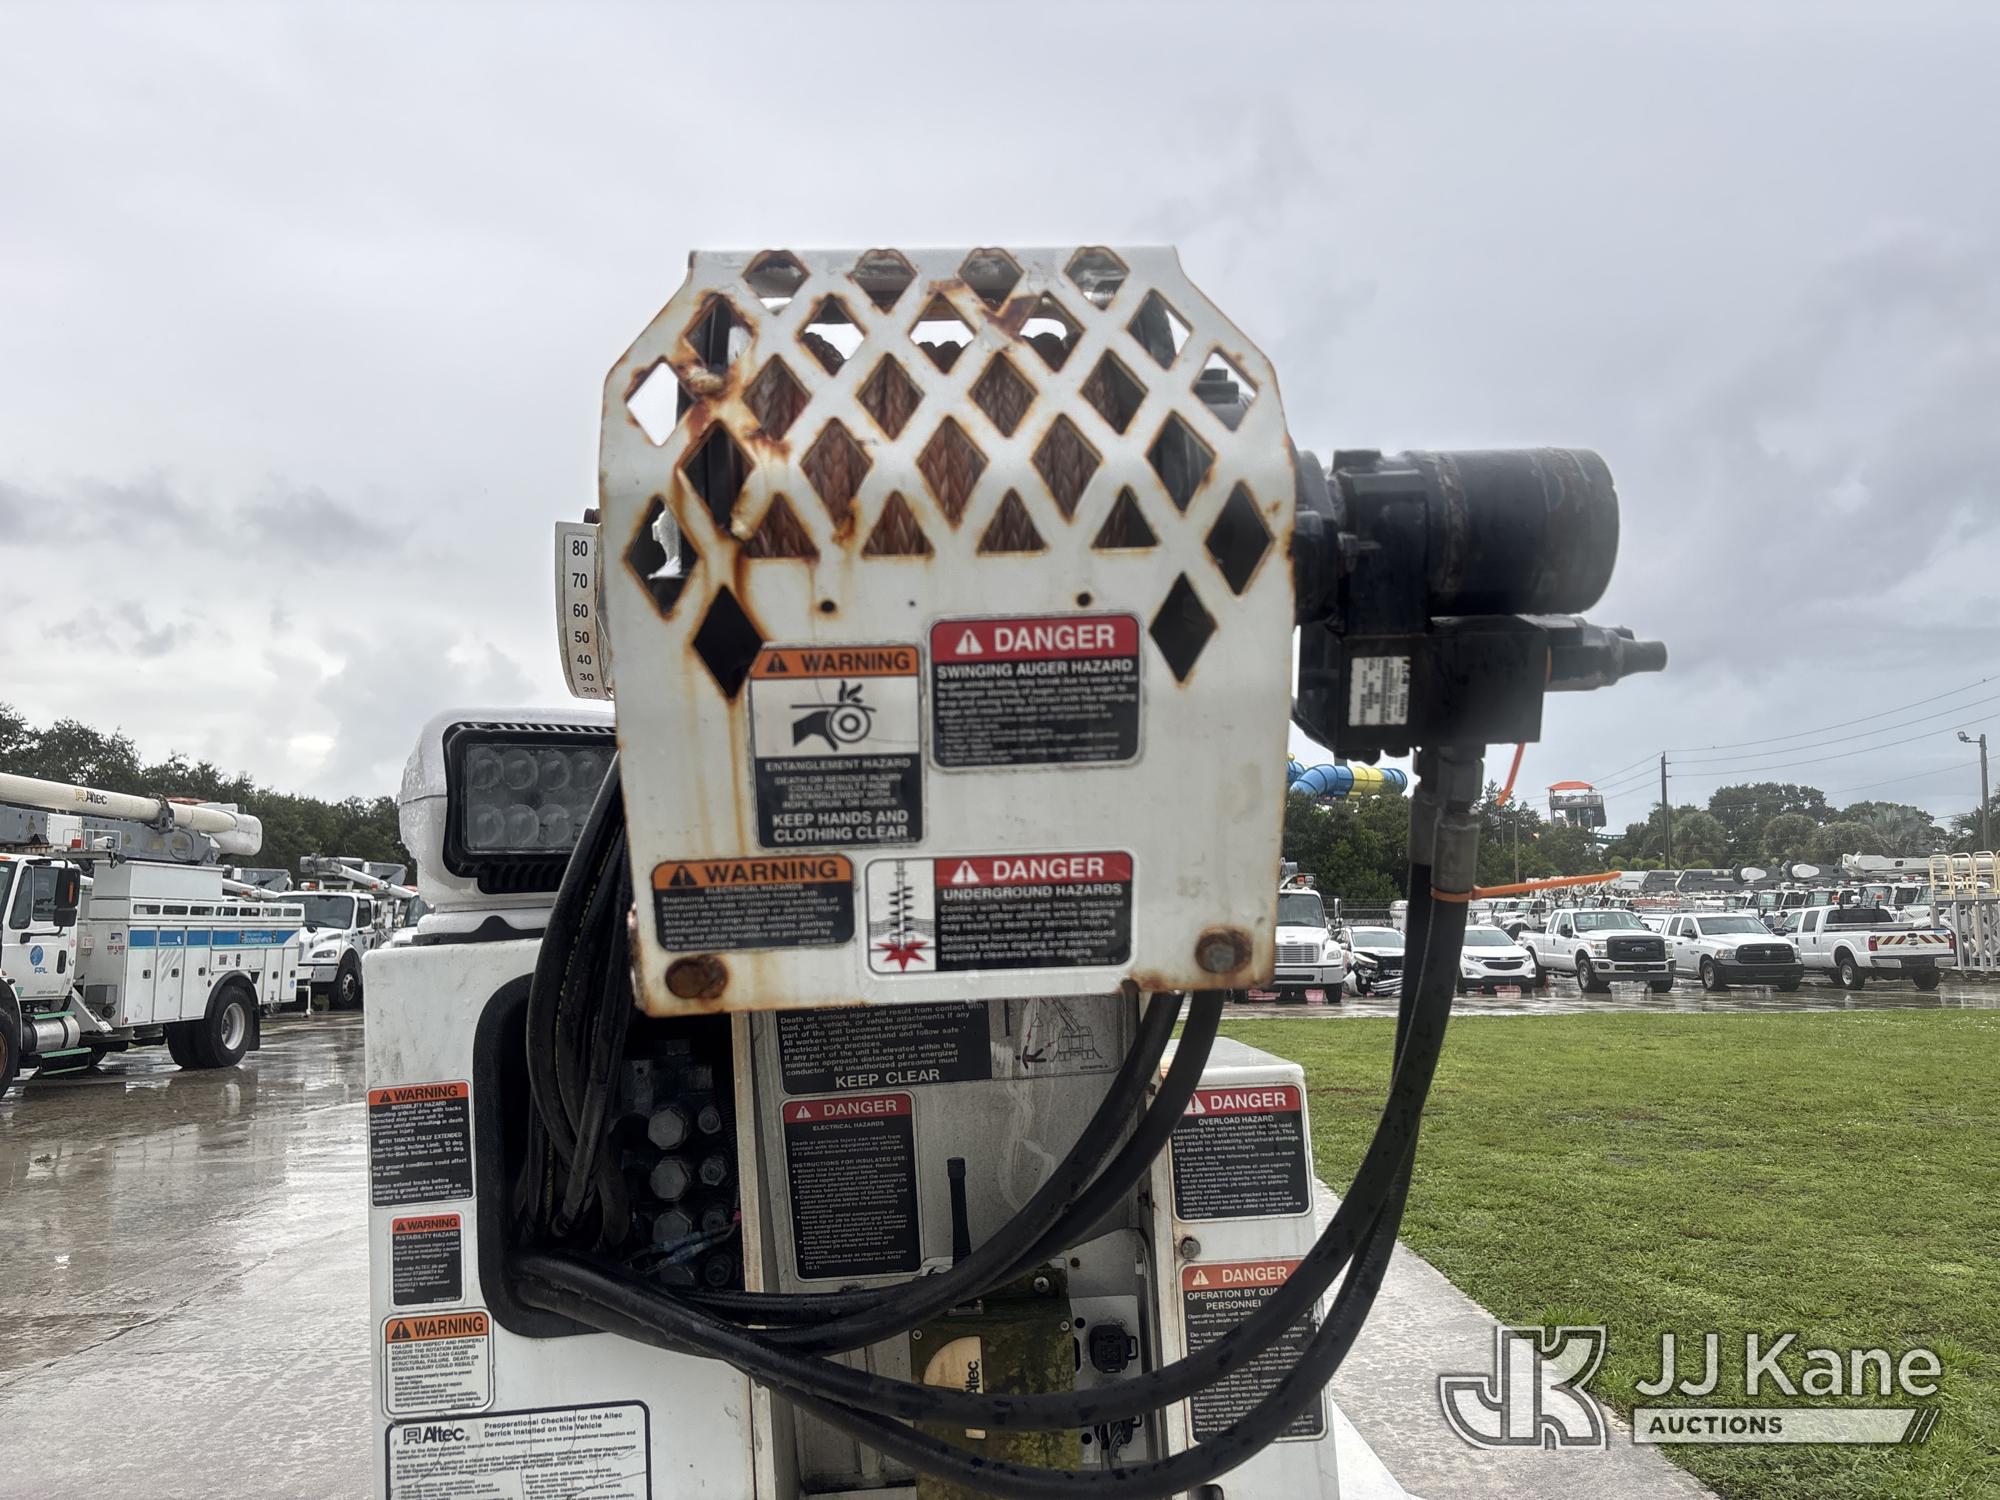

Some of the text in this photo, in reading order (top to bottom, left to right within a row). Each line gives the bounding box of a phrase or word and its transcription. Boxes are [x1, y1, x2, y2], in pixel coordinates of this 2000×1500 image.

[572, 540, 588, 556] 80
[572, 572, 588, 588] 70
[573, 604, 588, 618] 60
[574, 631, 590, 643] 50
[994, 626, 1115, 652] DANGER
[576, 654, 592, 665] 40
[801, 652, 911, 674] WARNING
[579, 673, 594, 681] 30
[937, 660, 1134, 678] SWINGING AUGER HAZARD
[765, 758, 912, 772] ENTANGLEMENT HAZARD
[773, 810, 911, 828] KEEP HANDS AND
[774, 825, 908, 843] CLOTHING CLEAR
[703, 860, 839, 884] WARNING
[993, 857, 1105, 881] DANGER
[943, 884, 1123, 901] UNDERGROUND HAZARDS
[896, 1014, 945, 1023] attachments
[845, 1026, 882, 1034] becomes
[884, 1023, 925, 1031] energized.
[852, 1033, 896, 1041] understand
[784, 1046, 820, 1054] electrical
[844, 1041, 881, 1049] practices.
[882, 1046, 915, 1054] elevated
[785, 1061, 820, 1069] minimum
[822, 1058, 858, 1066] approach
[861, 1055, 894, 1063] distance
[921, 1050, 958, 1058] energized
[786, 1067, 828, 1076] conductor.
[846, 1062, 895, 1071] unauthorized
[897, 1059, 935, 1067] personnel
[835, 1069, 941, 1088] KEEP CLEAR
[395, 1086, 458, 1101] WARNING
[1210, 1091, 1287, 1110] DANGER
[823, 1100, 897, 1116] DANGER
[812, 1123, 852, 1131] ELECTRICAL
[1198, 1115, 1274, 1125] OVERLOAD HAZARD
[406, 1217, 458, 1230] WARNING
[1222, 1266, 1288, 1283] DANGER
[1187, 1290, 1241, 1300] OPERATION
[1244, 1289, 1256, 1297] BY
[414, 1316, 484, 1337] WARNING
[484, 1413, 623, 1429] Preoperational Checklist for the Altec
[422, 1425, 465, 1443] Altec
[484, 1429, 513, 1438] Derrick
[513, 1427, 547, 1436] Installed
[575, 1422, 603, 1431] Vehicle
